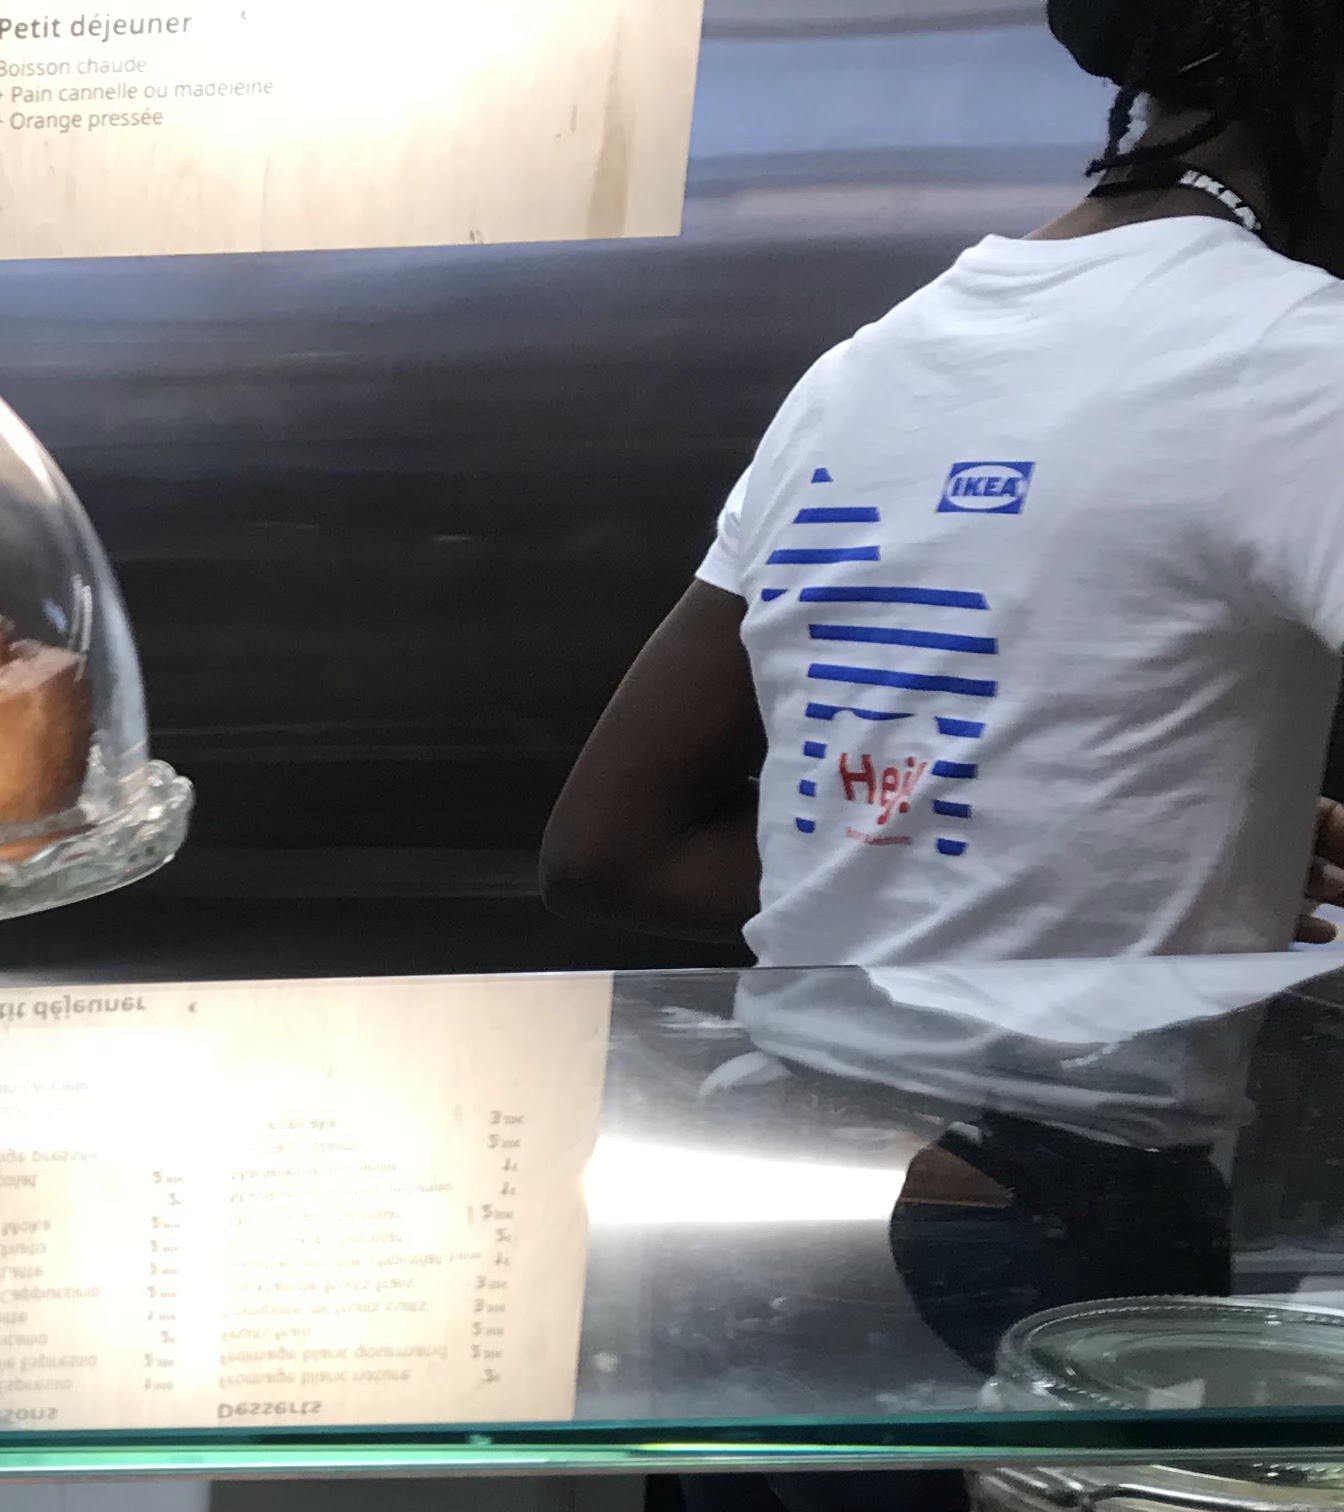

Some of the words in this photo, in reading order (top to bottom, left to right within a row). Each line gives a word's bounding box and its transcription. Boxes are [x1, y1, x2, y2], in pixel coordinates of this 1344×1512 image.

[70, 12, 193, 43] déjeuner
[76, 56, 147, 75] chaude
[10, 86, 53, 103] Pain
[58, 83, 137, 101] cannelle
[143, 84, 170, 98] ou
[9, 113, 83, 134] Orange
[88, 108, 164, 131] pressée
[950, 475, 1018, 499] IKEA
